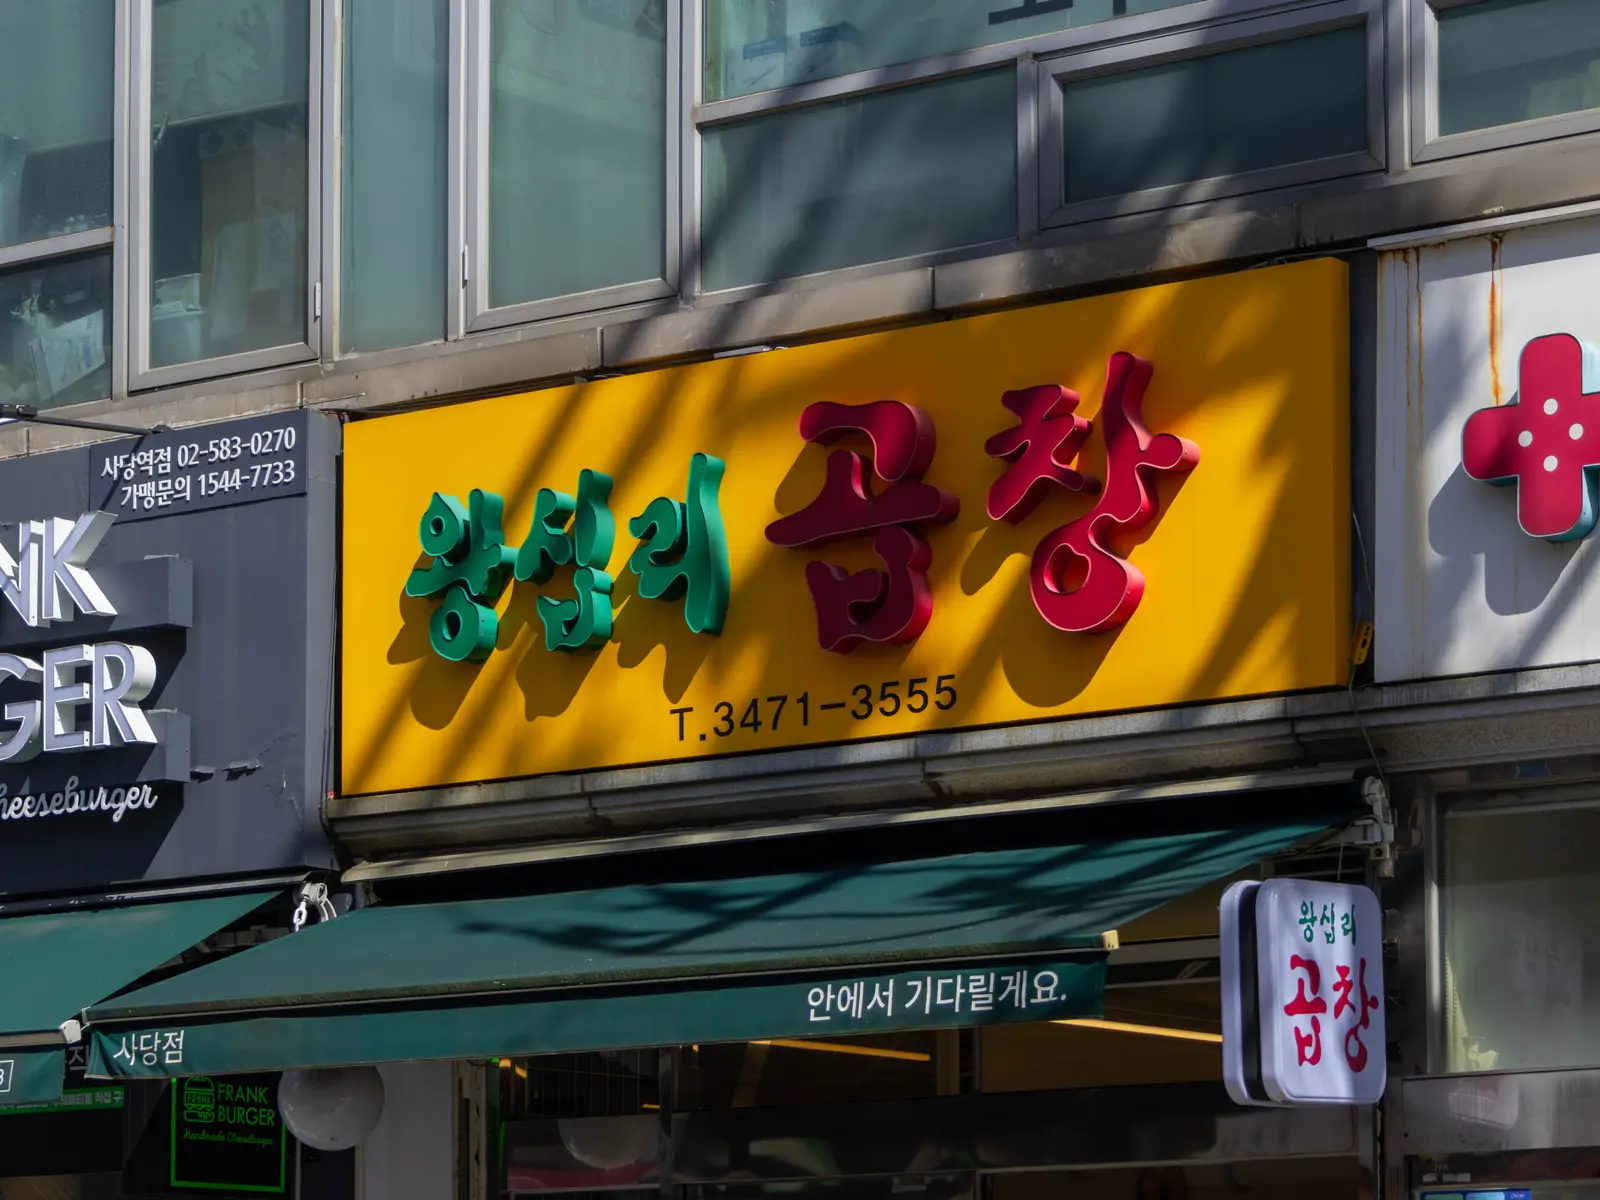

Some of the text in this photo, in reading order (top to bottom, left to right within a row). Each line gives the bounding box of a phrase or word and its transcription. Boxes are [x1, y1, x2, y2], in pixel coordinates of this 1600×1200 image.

[101, 426, 296, 481] 사당역점 02-583-0270
[121, 459, 295, 510] 가맹문의 1544-7733
[405, 351, 1201, 663] 왕십리 곱창
[670, 674, 957, 741] T.3471-3555
[1299, 900, 1356, 946] 왕십리
[807, 970, 1067, 1022] 안에서 기다릴게요.
[1284, 954, 1379, 1073] 곱창
[113, 1029, 185, 1066] 사당점
[218, 1083, 268, 1105] FRANK
[218, 1105, 275, 1127] BURGER
